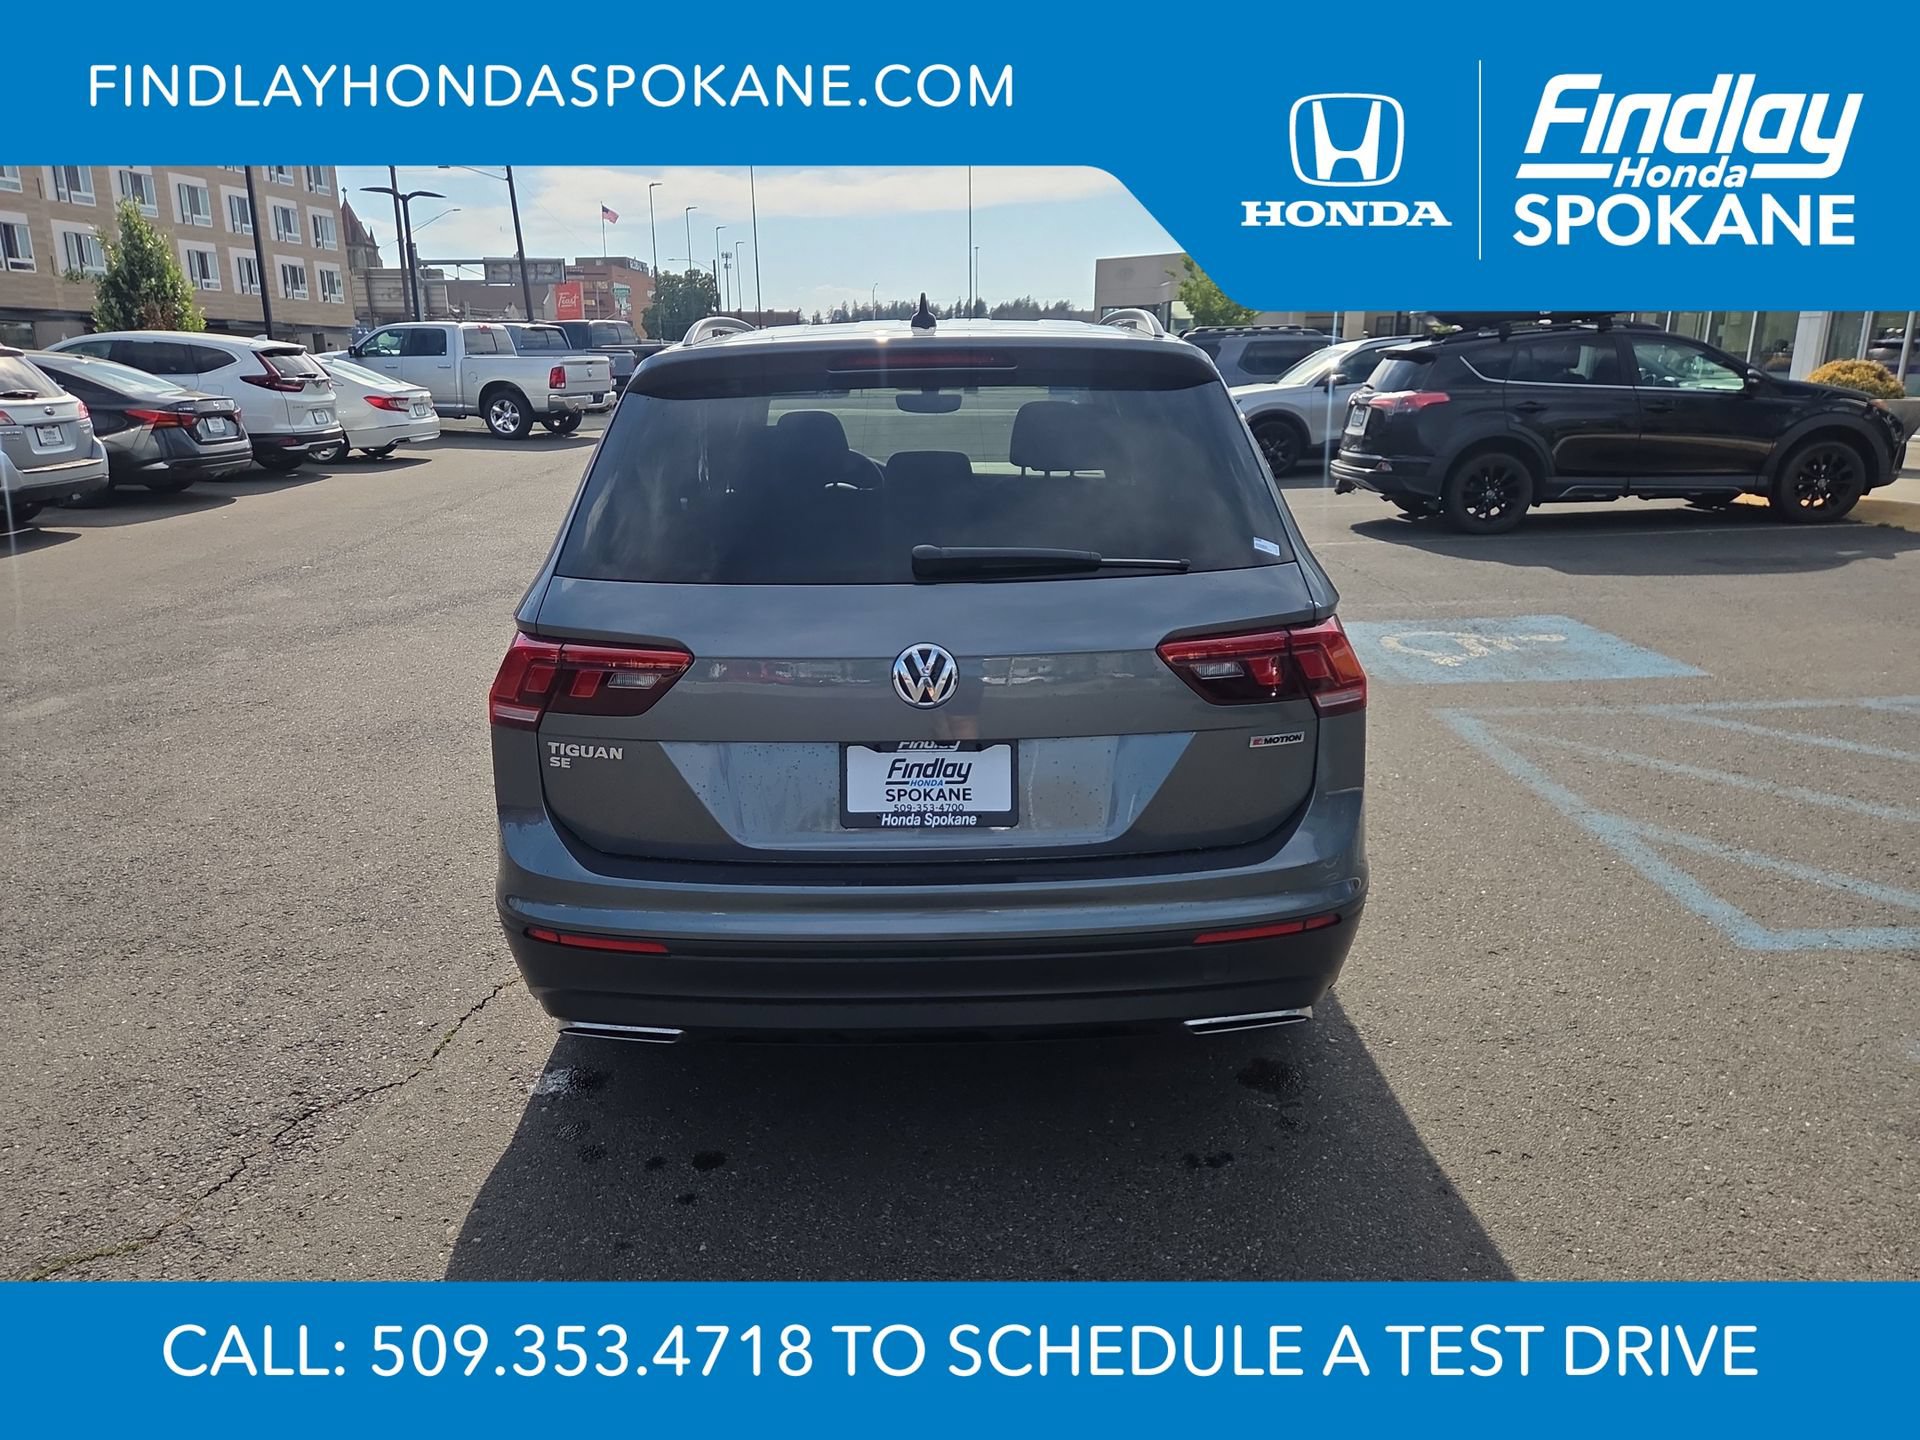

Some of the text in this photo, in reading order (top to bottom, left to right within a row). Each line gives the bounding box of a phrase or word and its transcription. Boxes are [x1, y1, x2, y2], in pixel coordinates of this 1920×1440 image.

[547, 741, 623, 760] TIGUAN
[549, 756, 571, 768] SE
[886, 757, 972, 785] Findlay
[909, 779, 944, 787] HONDA
[885, 788, 972, 802] SPOKANE
[893, 803, 965, 812] 509-353-4700
[881, 813, 977, 828] Honda Spokane
